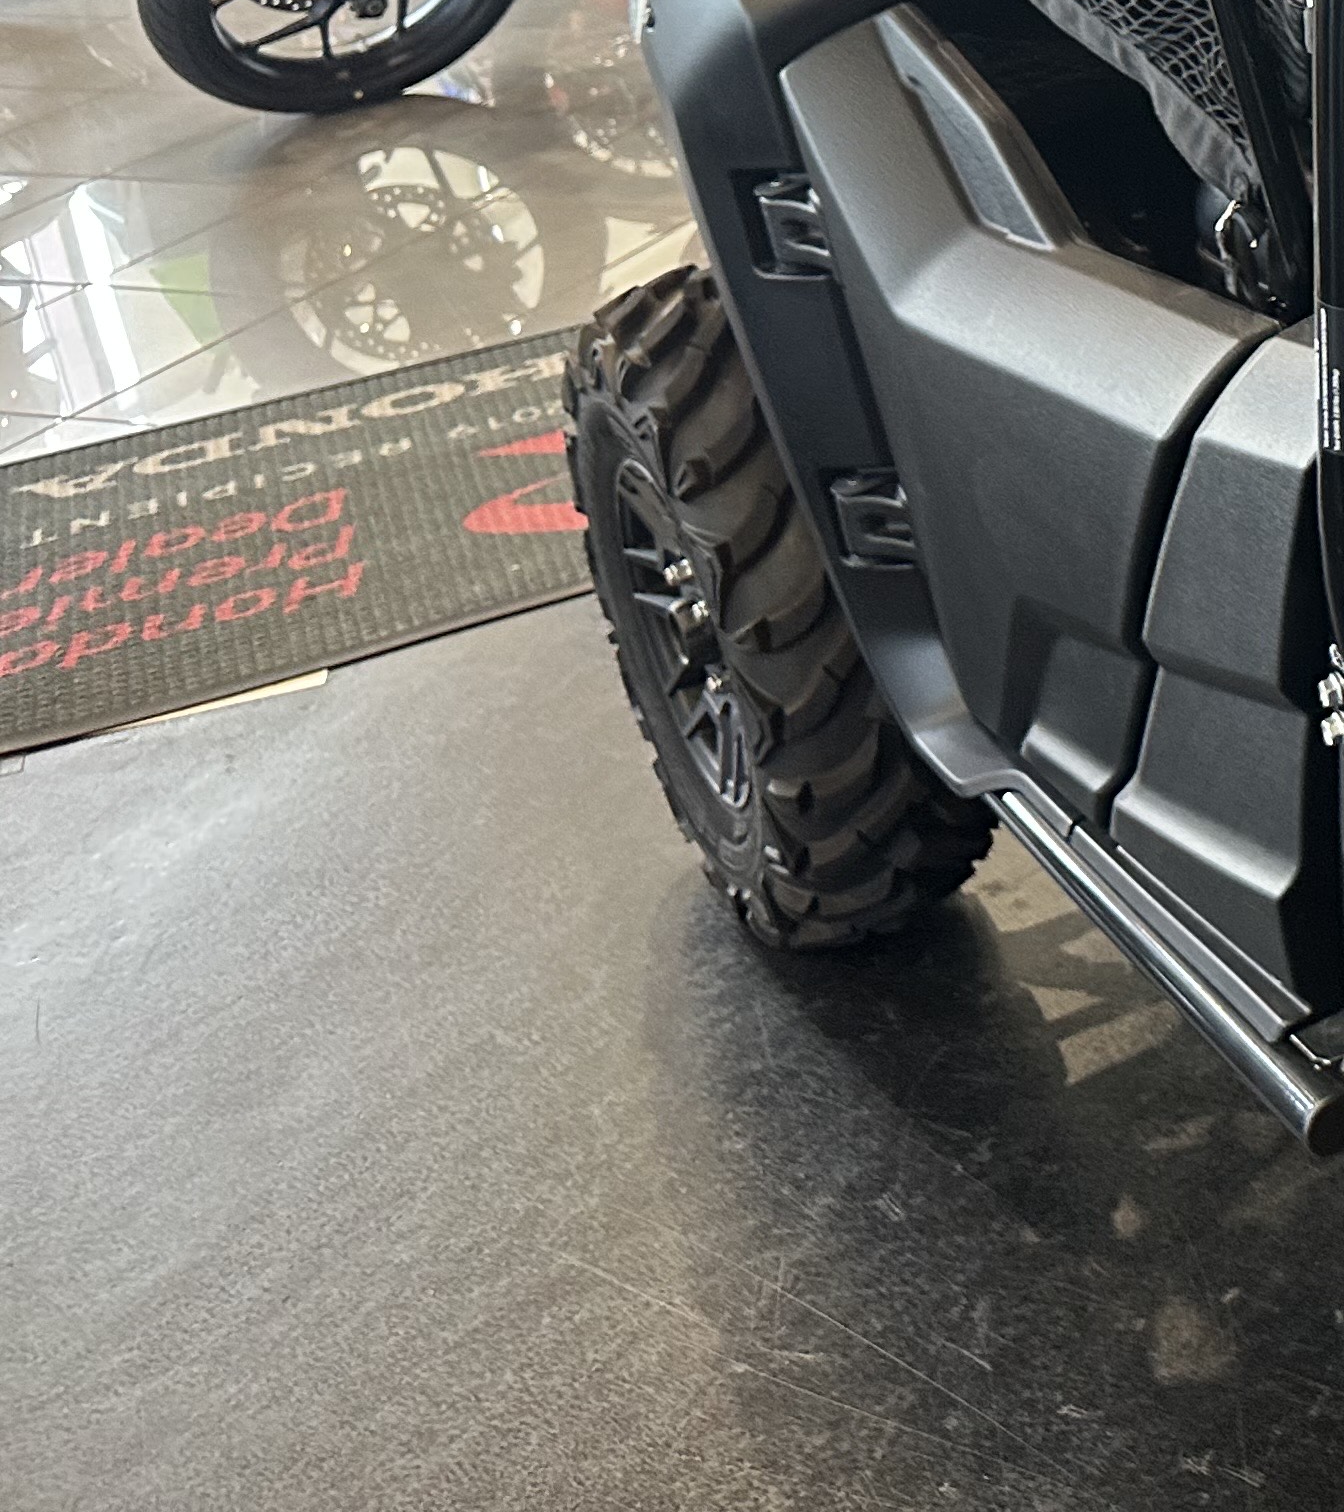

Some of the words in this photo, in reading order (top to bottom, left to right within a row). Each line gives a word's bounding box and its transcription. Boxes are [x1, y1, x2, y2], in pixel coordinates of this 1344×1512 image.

[11, 349, 571, 499] HONDA
[0, 486, 349, 602] Dealer
[17, 435, 413, 550] RECIPIENT
[0, 523, 357, 638] Premie
